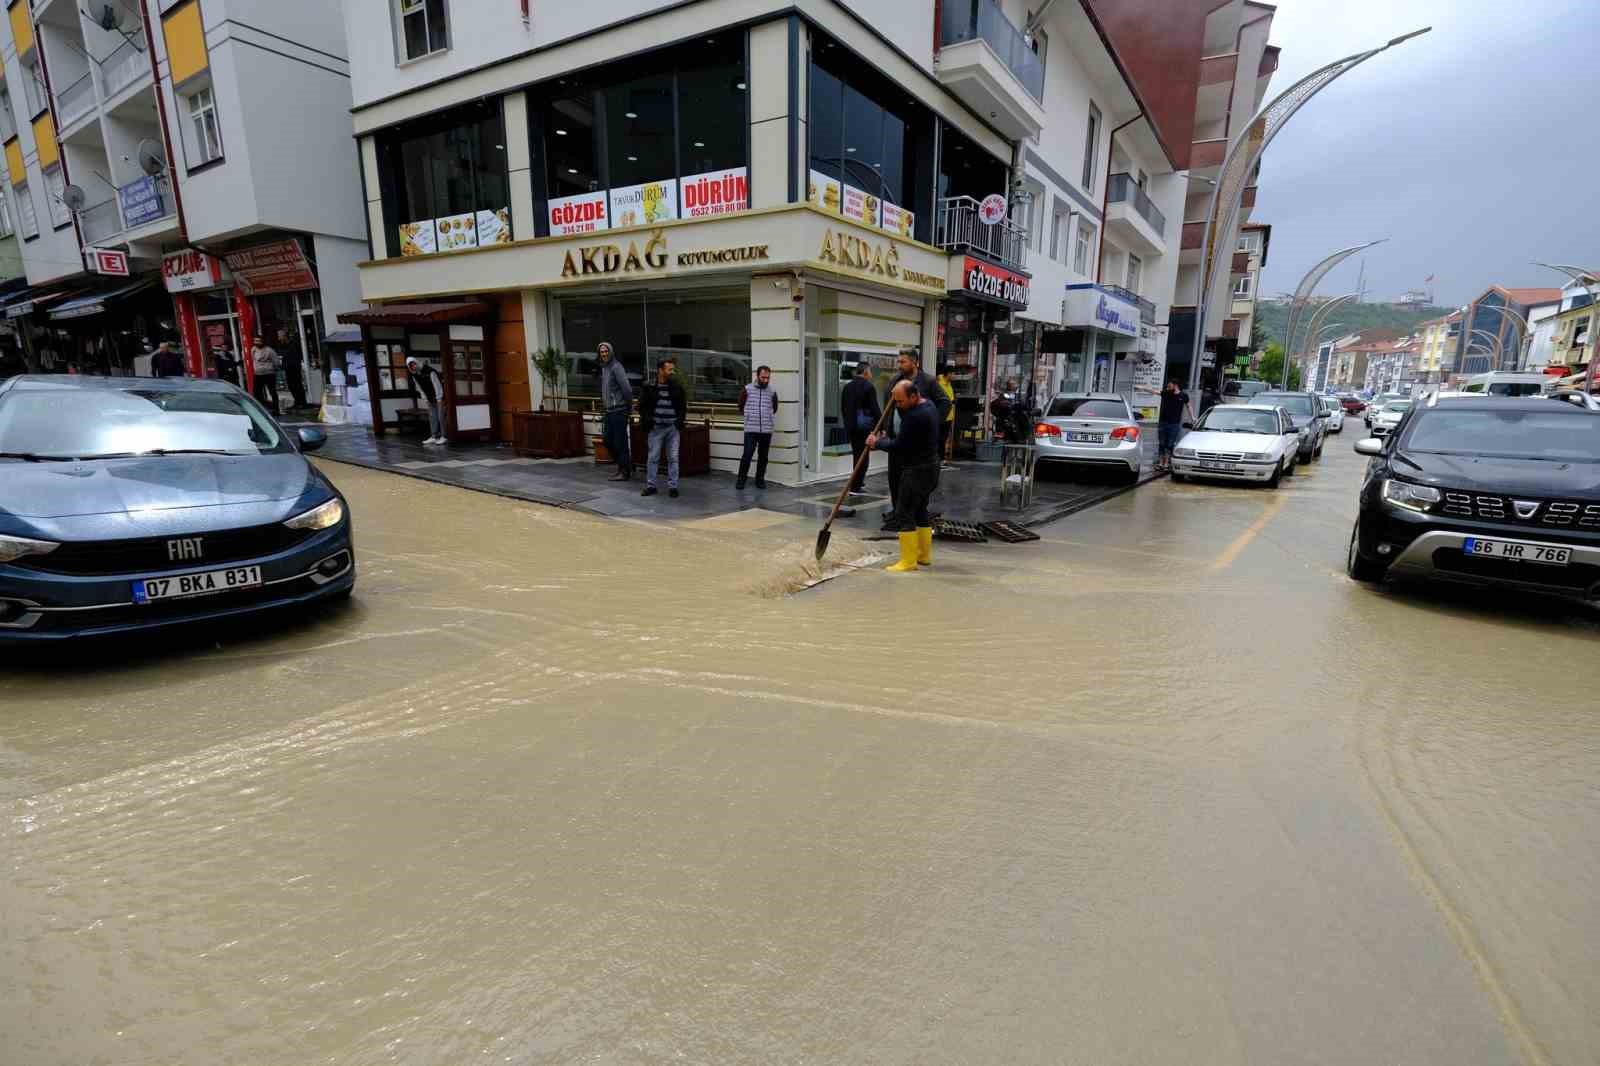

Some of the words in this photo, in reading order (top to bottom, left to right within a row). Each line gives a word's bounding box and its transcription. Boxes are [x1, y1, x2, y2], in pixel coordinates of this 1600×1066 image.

[551, 200, 605, 225] GÖZDE
[691, 206, 709, 216] 0532
[561, 230, 668, 276] AKDAĞ
[678, 245, 768, 264] KUYUMCULUK
[819, 229, 898, 277] AKDAĞ
[969, 265, 1001, 297] GÖZDE
[168, 537, 203, 560] FIAT
[1473, 541, 1493, 553] 66
[1503, 544, 1525, 557] HR
[1535, 547, 1567, 561] 766
[146, 580, 170, 598] 07
[180, 574, 215, 592] BKA
[225, 568, 259, 585] 831
